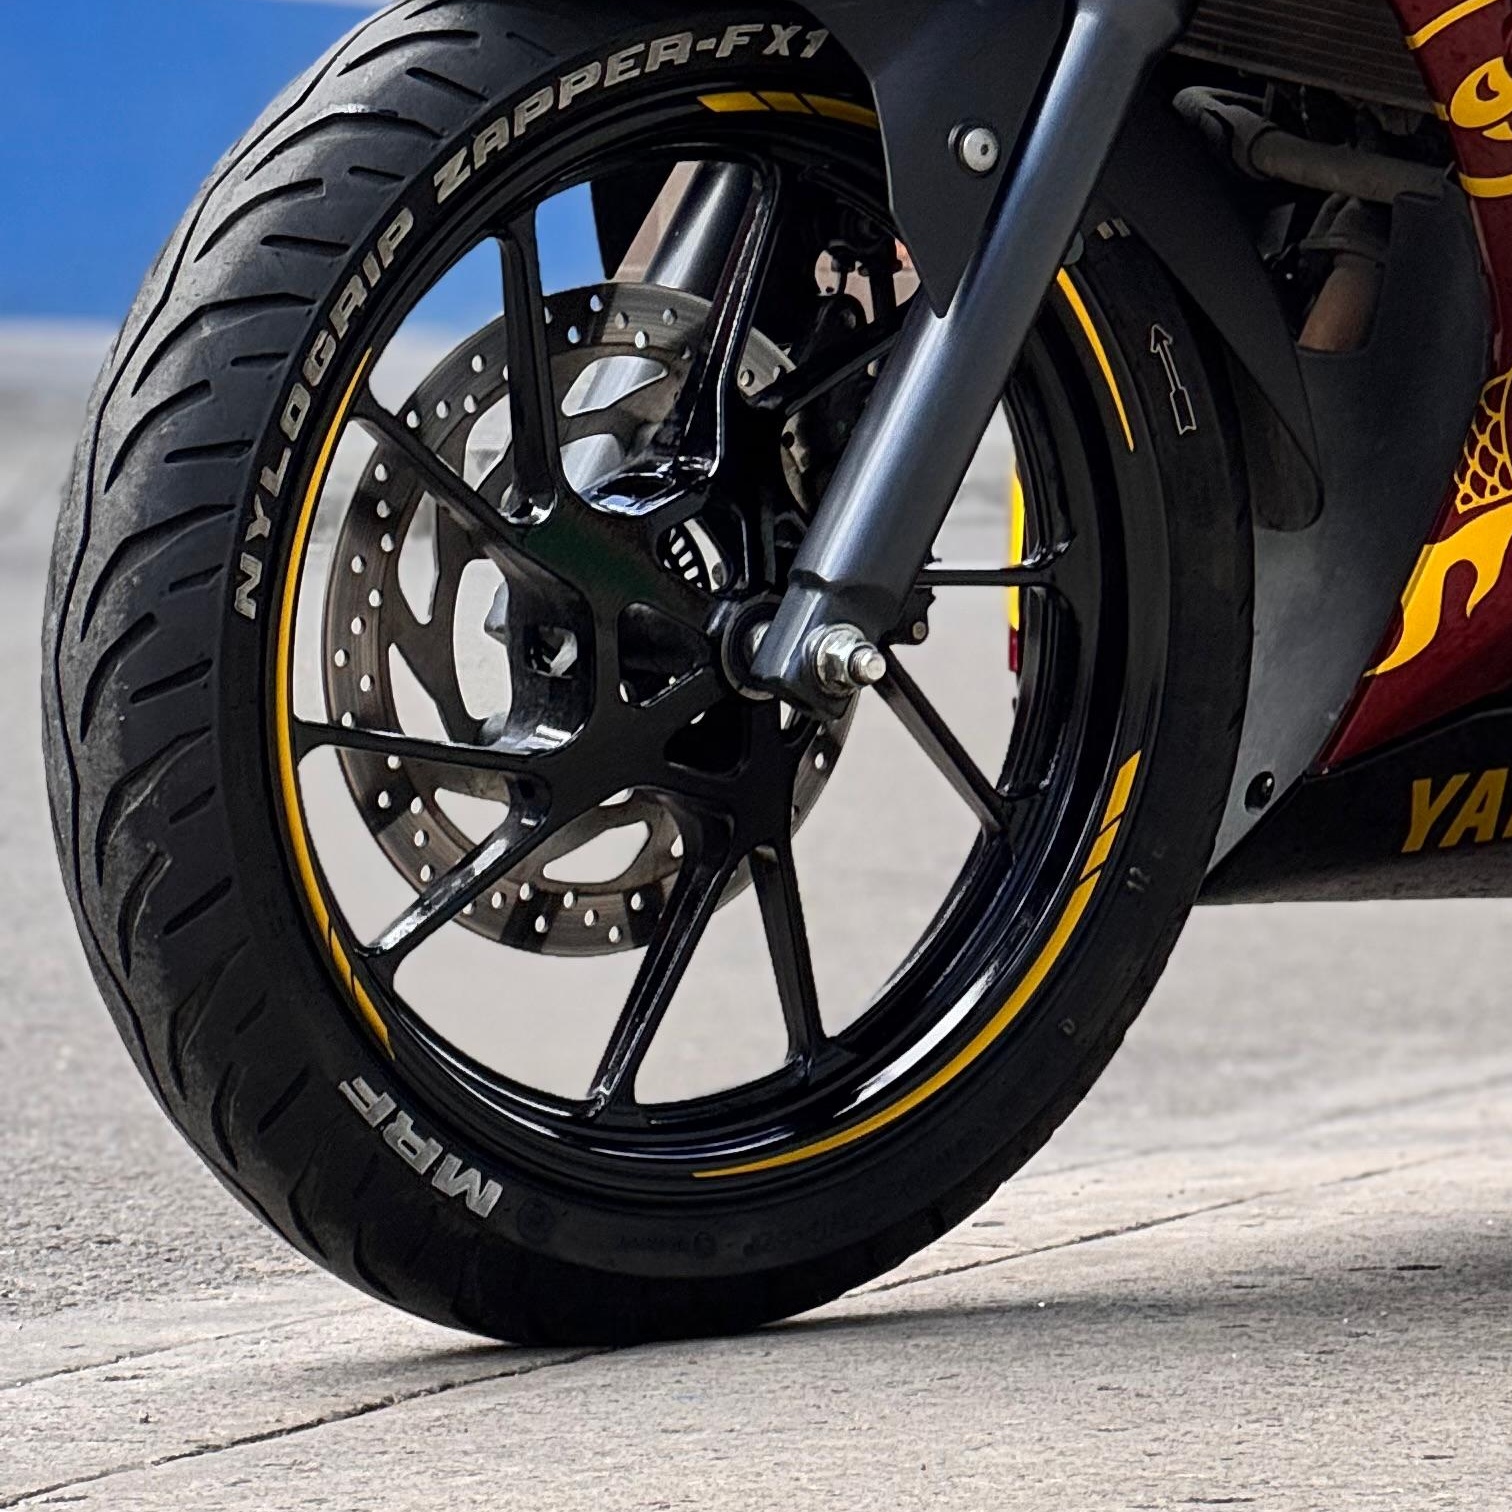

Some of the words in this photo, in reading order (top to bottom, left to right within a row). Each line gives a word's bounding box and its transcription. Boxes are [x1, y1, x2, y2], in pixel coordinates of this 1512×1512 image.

[234, 210, 414, 620] NYLOGRIP
[433, 22, 830, 205] ZAPPER-FX1
[338, 1075, 504, 1219] MRF
